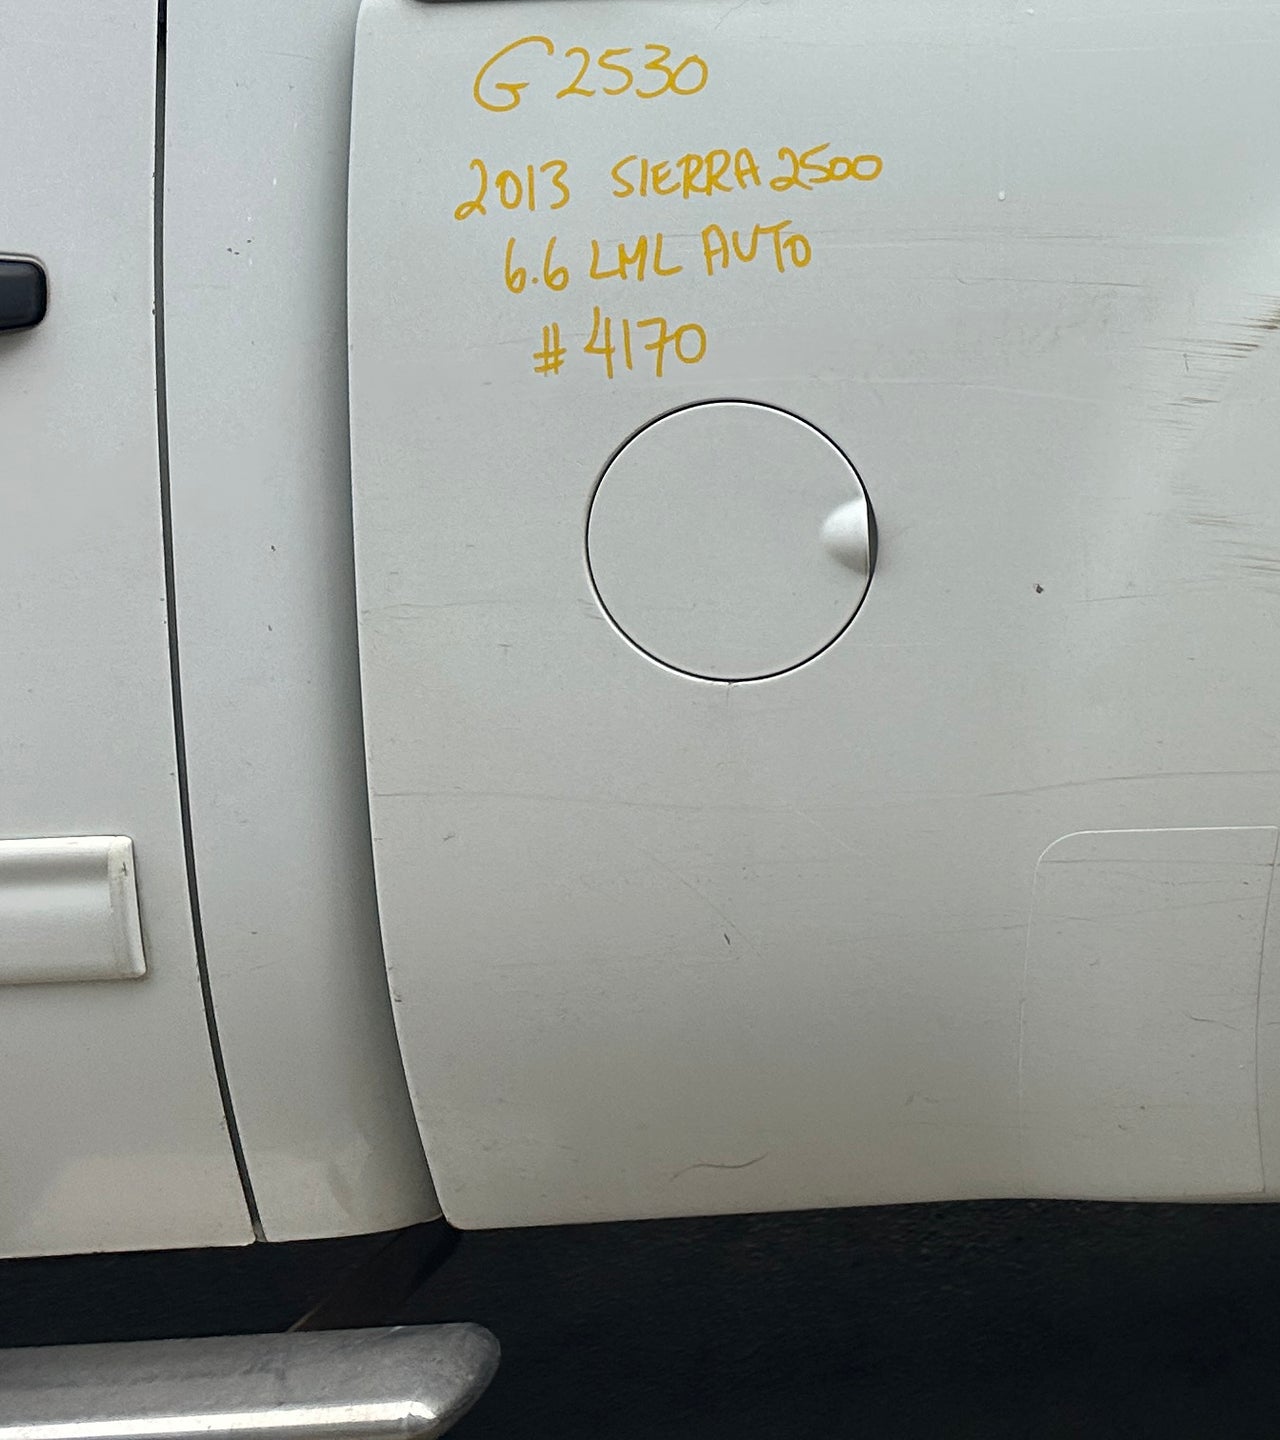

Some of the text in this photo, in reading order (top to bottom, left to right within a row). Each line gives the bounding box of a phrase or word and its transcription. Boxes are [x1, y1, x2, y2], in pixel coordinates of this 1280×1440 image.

[454, 143, 883, 221] 2013 SIERRA 2500
[504, 220, 812, 294] 6.6 LML AUTO
